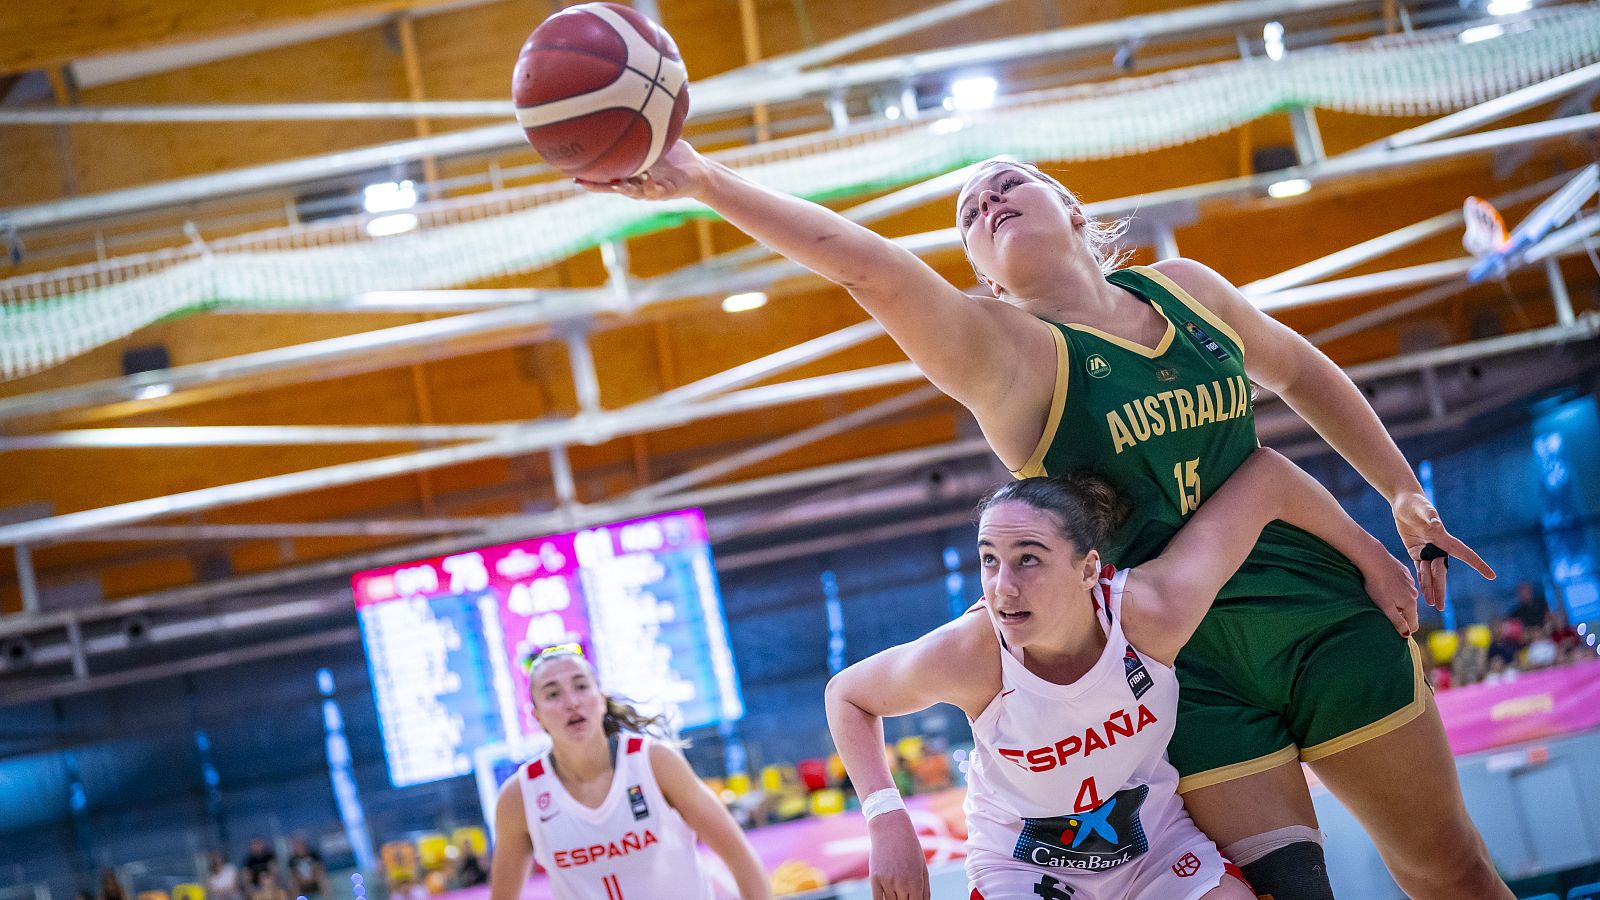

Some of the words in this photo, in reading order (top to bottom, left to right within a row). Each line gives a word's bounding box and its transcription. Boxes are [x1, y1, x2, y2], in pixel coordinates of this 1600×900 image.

[1106, 375, 1247, 455] AUSTRALIA
[1173, 457, 1201, 516] 15
[1129, 671, 1146, 688] FIBA
[1073, 776, 1104, 814] 4
[554, 829, 658, 868] ESPAÑA
[1031, 846, 1132, 869] CaixaBank
